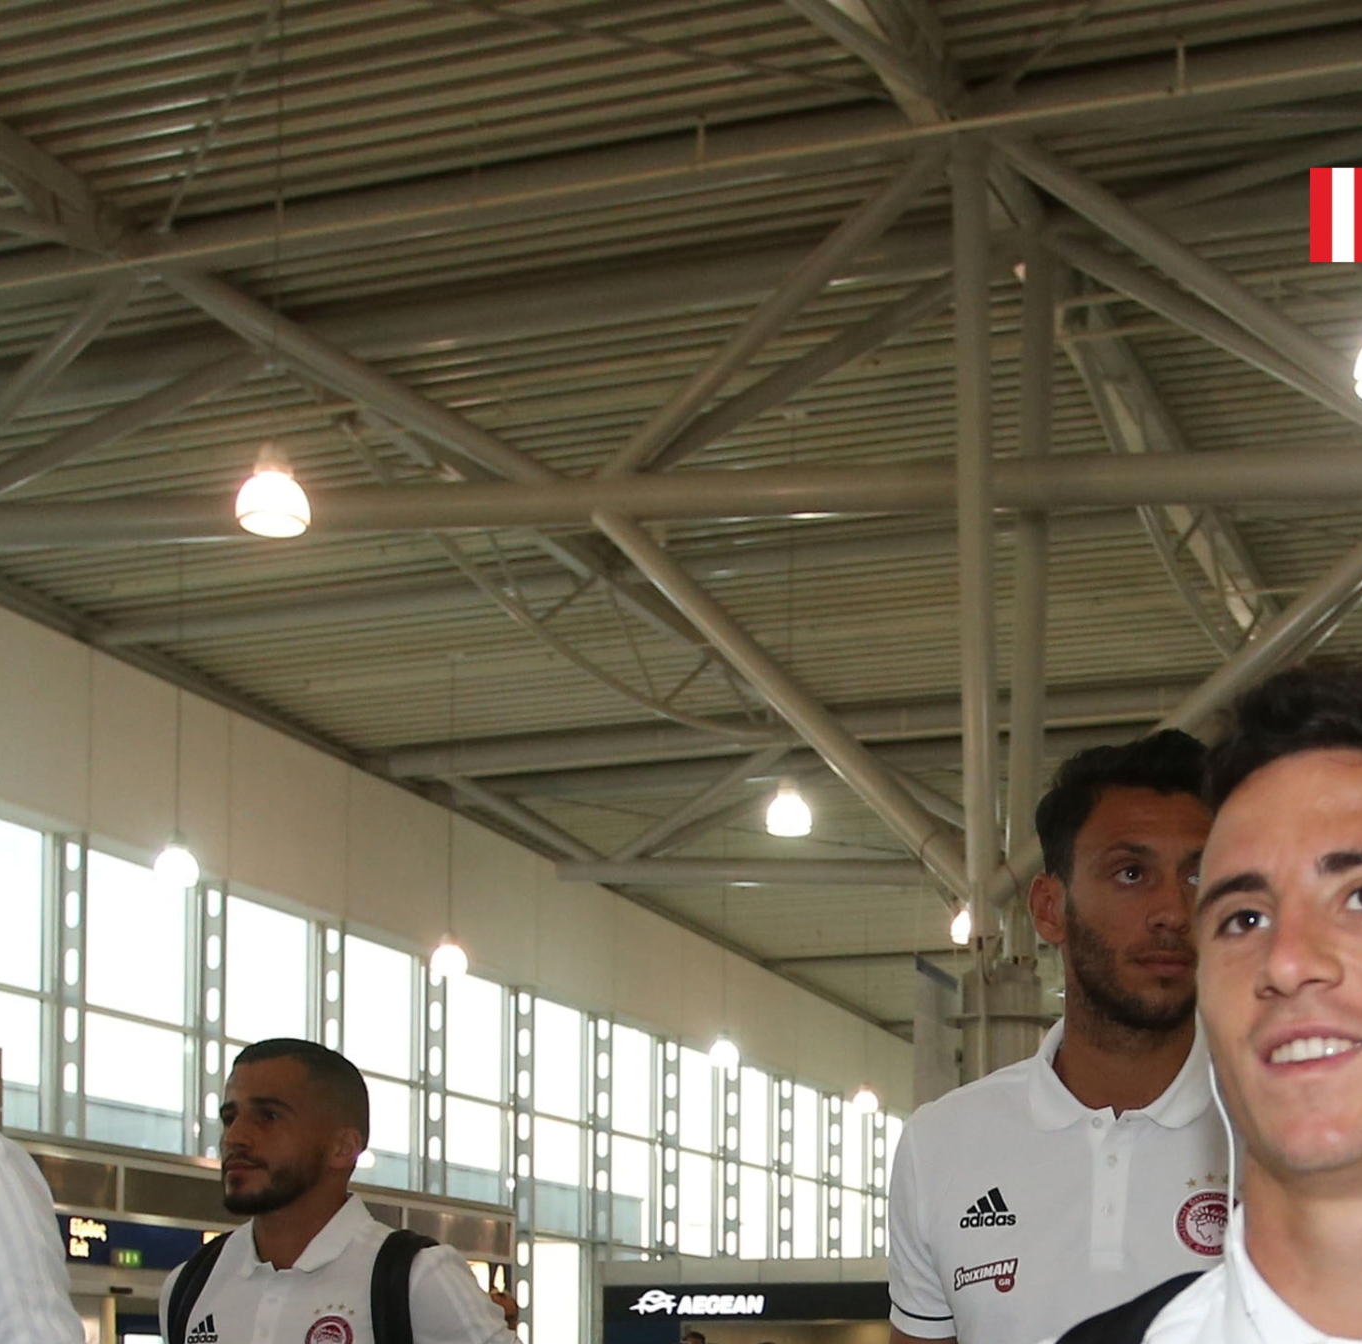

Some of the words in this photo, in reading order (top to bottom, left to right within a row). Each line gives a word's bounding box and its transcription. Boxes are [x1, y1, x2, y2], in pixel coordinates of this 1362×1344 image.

[960, 1212, 1016, 1229] adidas
[955, 1259, 1017, 1291] STOIXIMAN
[677, 1294, 765, 1315] AEGEAN
[187, 1332, 219, 1344] adidas
